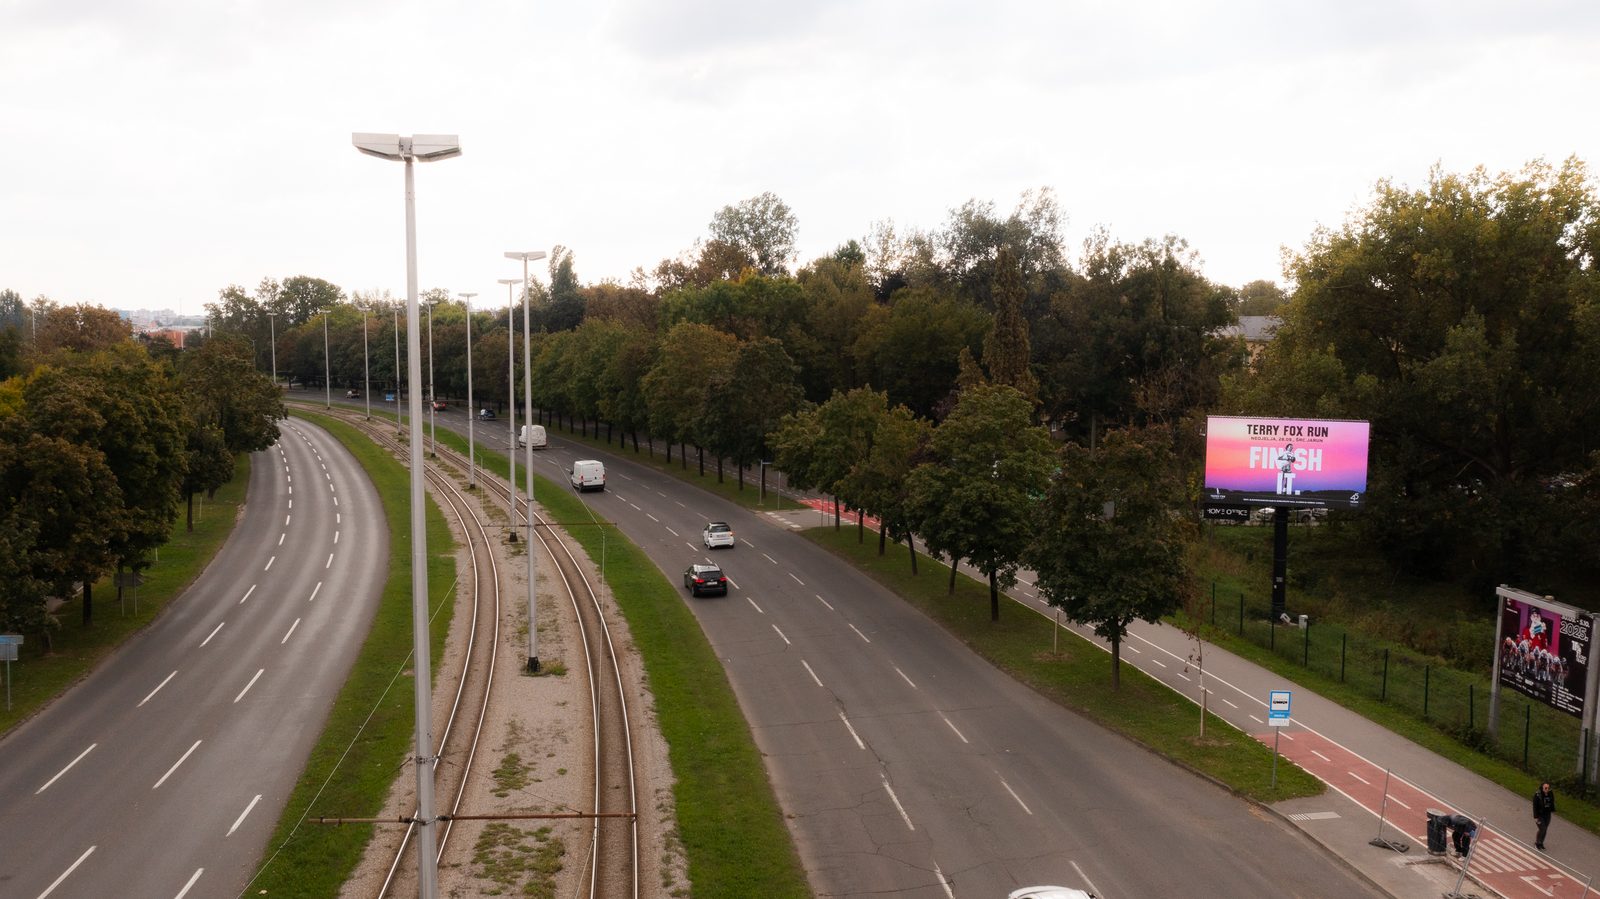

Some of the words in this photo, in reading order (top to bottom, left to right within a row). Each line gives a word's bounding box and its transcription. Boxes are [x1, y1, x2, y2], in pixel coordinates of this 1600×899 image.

[1247, 424, 1279, 436] TERRY
[1283, 425, 1303, 437] FOX
[1307, 426, 1329, 437] RUN
[1560, 621, 1589, 642] 2025.
